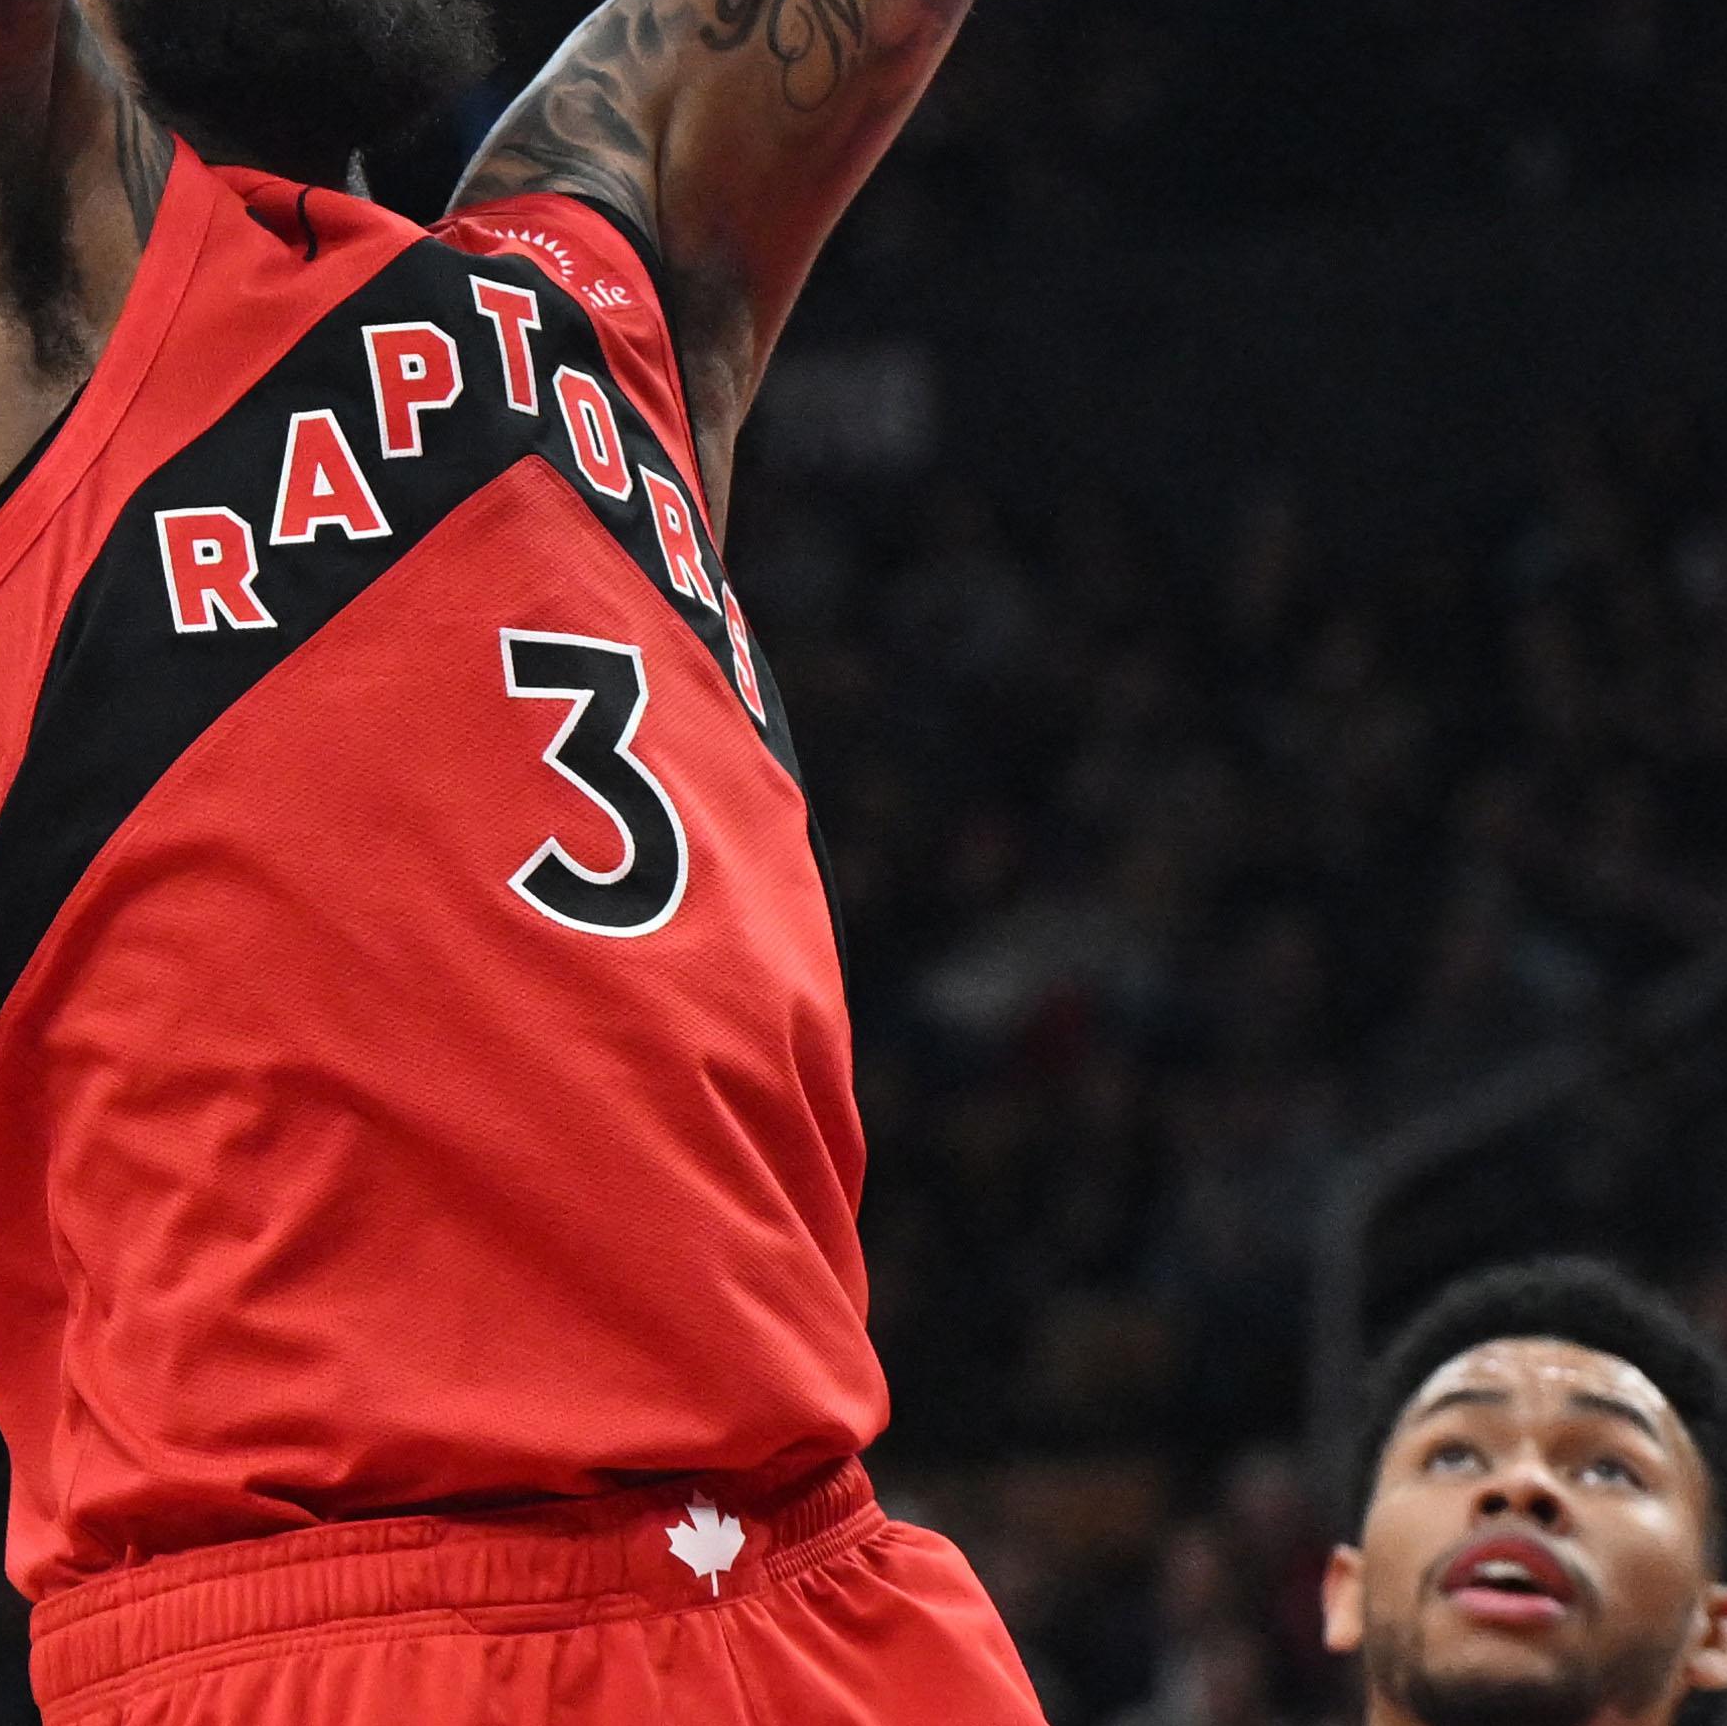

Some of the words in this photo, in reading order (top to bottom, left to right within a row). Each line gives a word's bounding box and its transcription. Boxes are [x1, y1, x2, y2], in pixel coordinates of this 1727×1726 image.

[582, 278, 632, 309] ife
[155, 274, 766, 727] RAPTORS
[500, 628, 688, 938] 3
